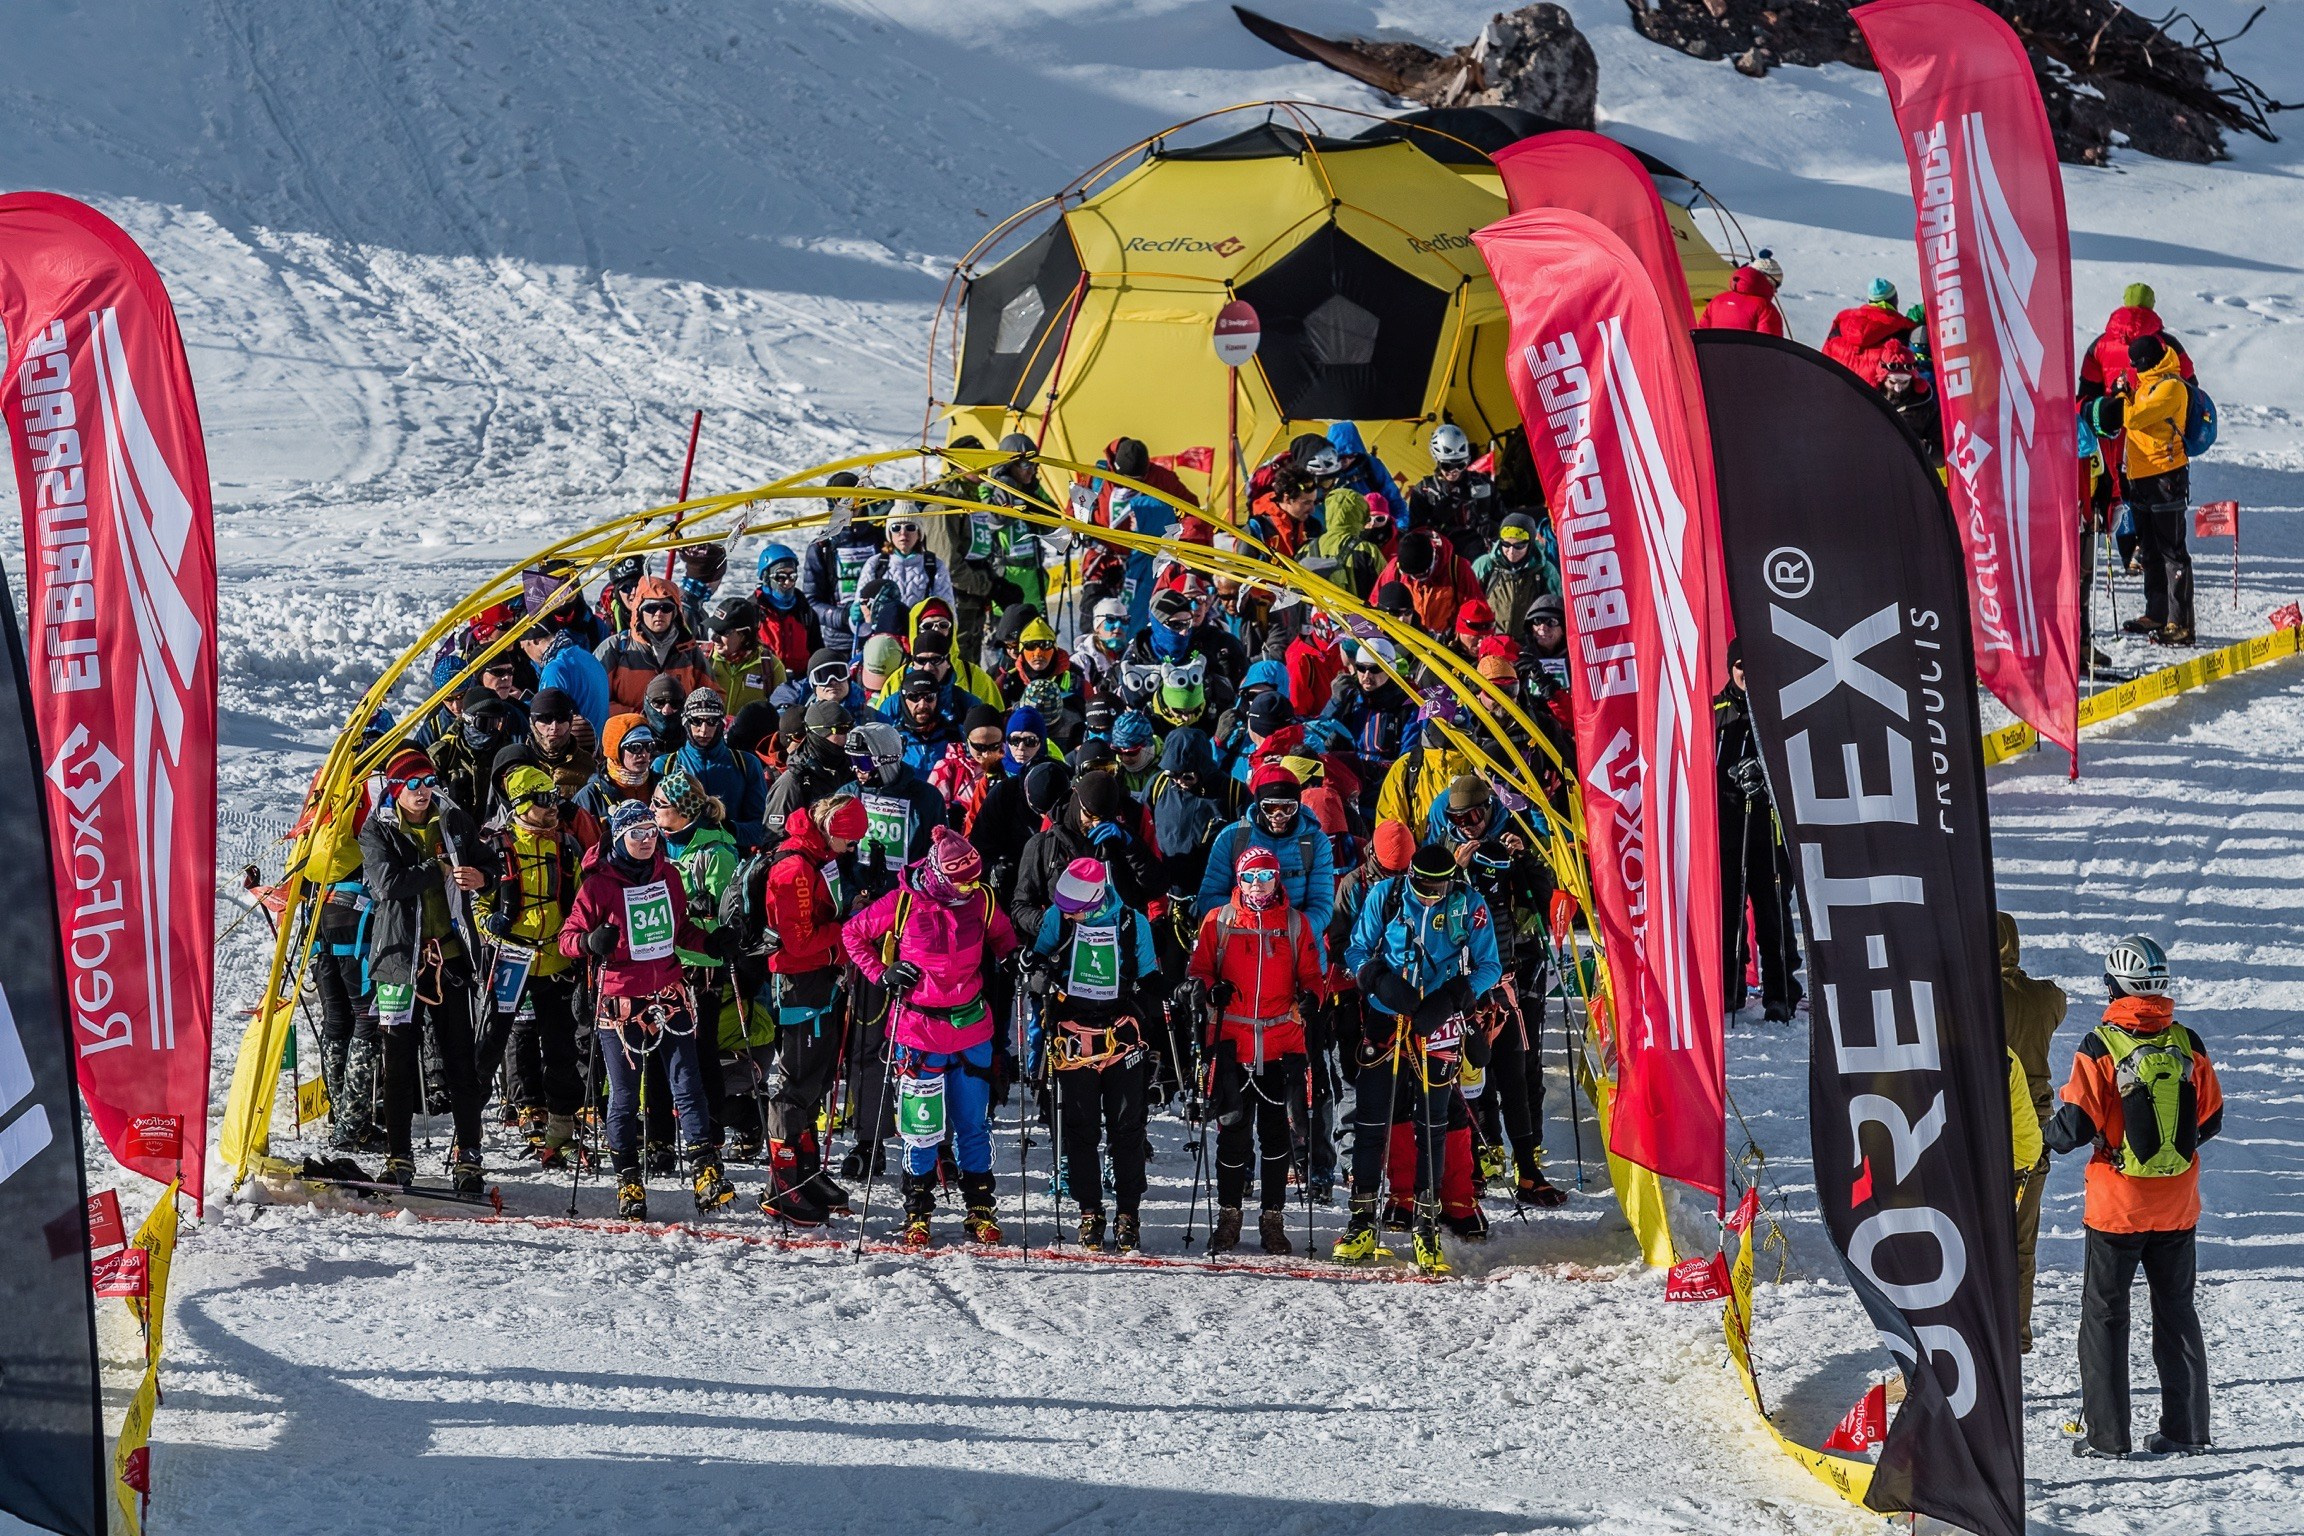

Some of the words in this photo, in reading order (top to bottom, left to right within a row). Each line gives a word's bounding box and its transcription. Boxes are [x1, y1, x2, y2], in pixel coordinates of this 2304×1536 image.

[1124, 237, 1216, 253] RedFox
[1407, 233, 1471, 254] RedFox
[633, 904, 668, 930] 341
[917, 1102, 930, 1121] 6
[1855, 1398, 1866, 1432] edFox
